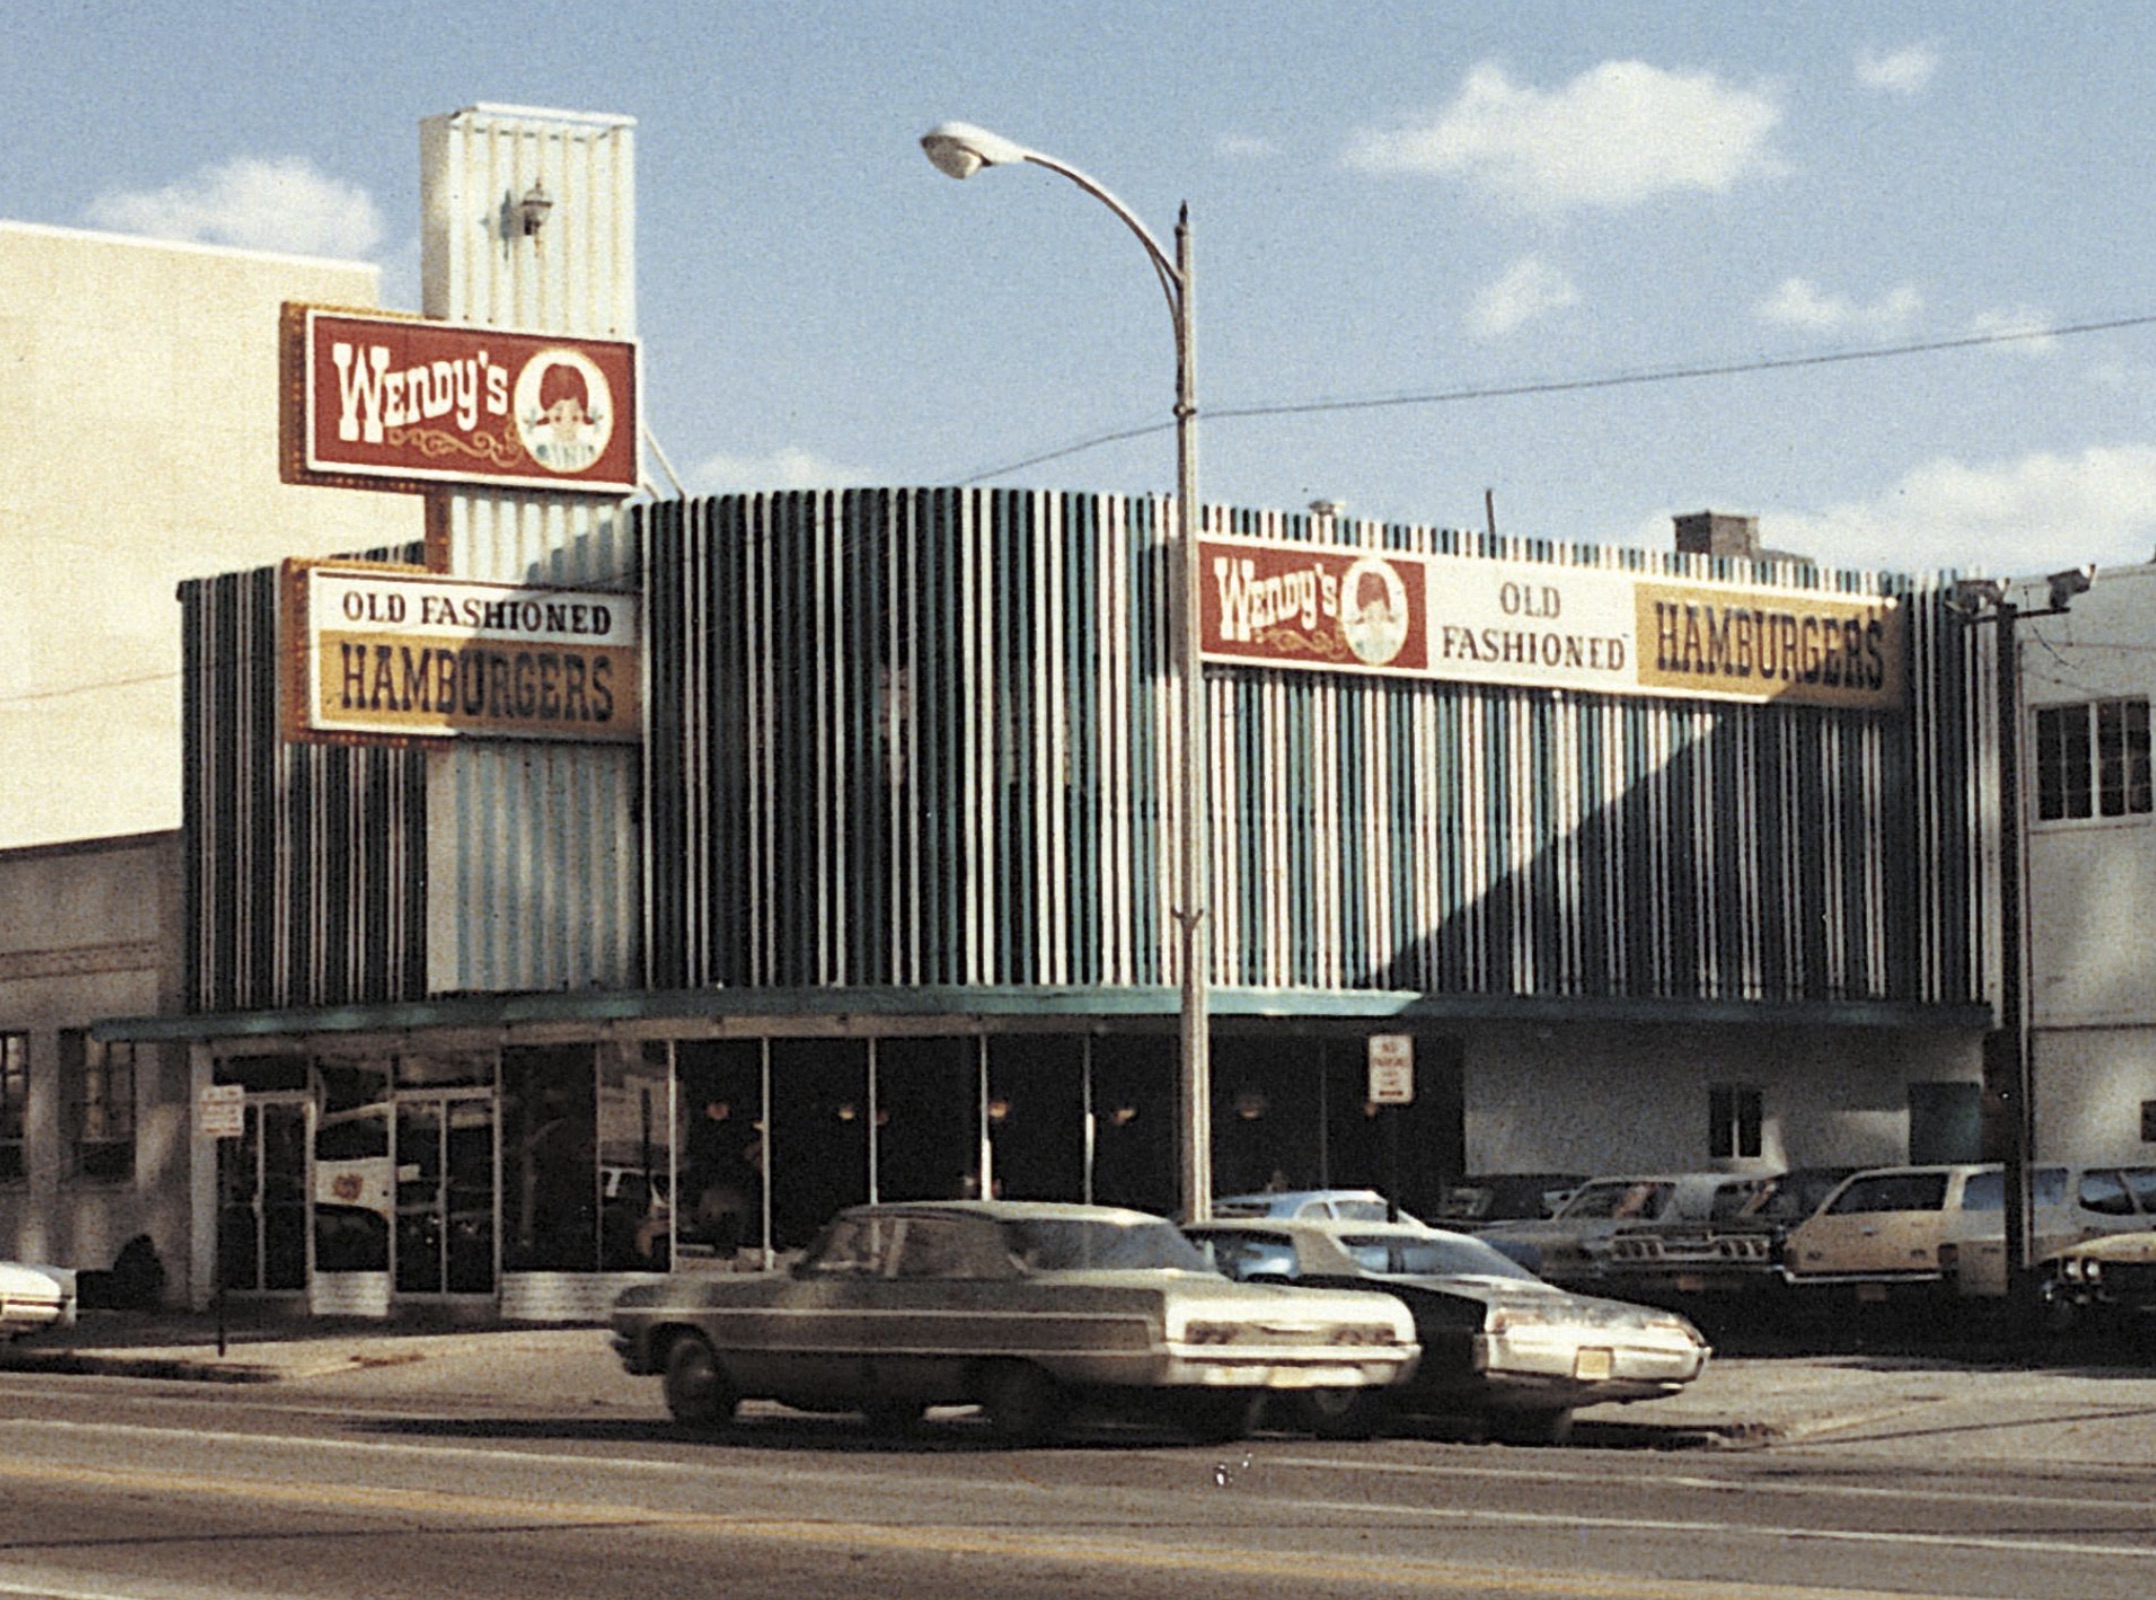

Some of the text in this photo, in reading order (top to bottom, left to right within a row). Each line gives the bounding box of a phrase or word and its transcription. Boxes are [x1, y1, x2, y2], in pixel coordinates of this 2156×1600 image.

[342, 591, 612, 635] OLD FASHIONED
[1500, 581, 1561, 619] OLD
[1442, 625, 1625, 671] FASHIONED
[1655, 601, 1884, 690] HAMBURGERS
[340, 641, 613, 722] HAMBURGERS
